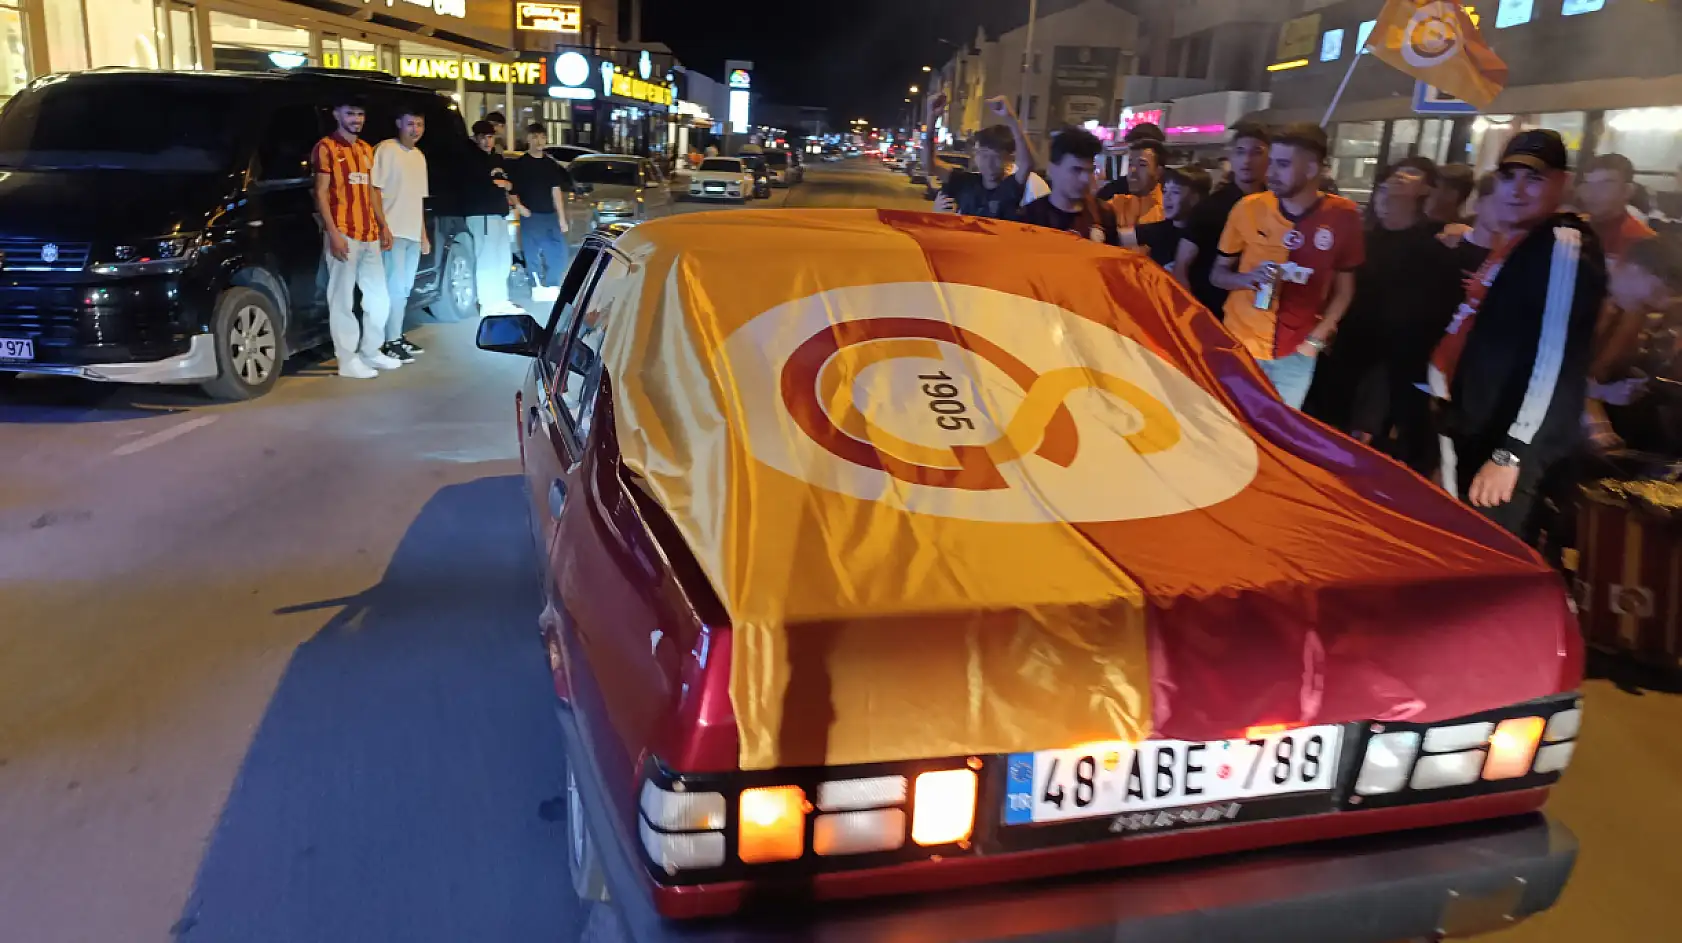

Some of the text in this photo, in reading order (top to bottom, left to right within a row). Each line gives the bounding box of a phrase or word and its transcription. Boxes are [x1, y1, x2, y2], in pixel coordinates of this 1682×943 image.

[400, 58, 486, 81] MANGAL
[6, 340, 33, 357] 971
[917, 369, 976, 431] 1905
[1042, 735, 1324, 810] 48 ABE 788
